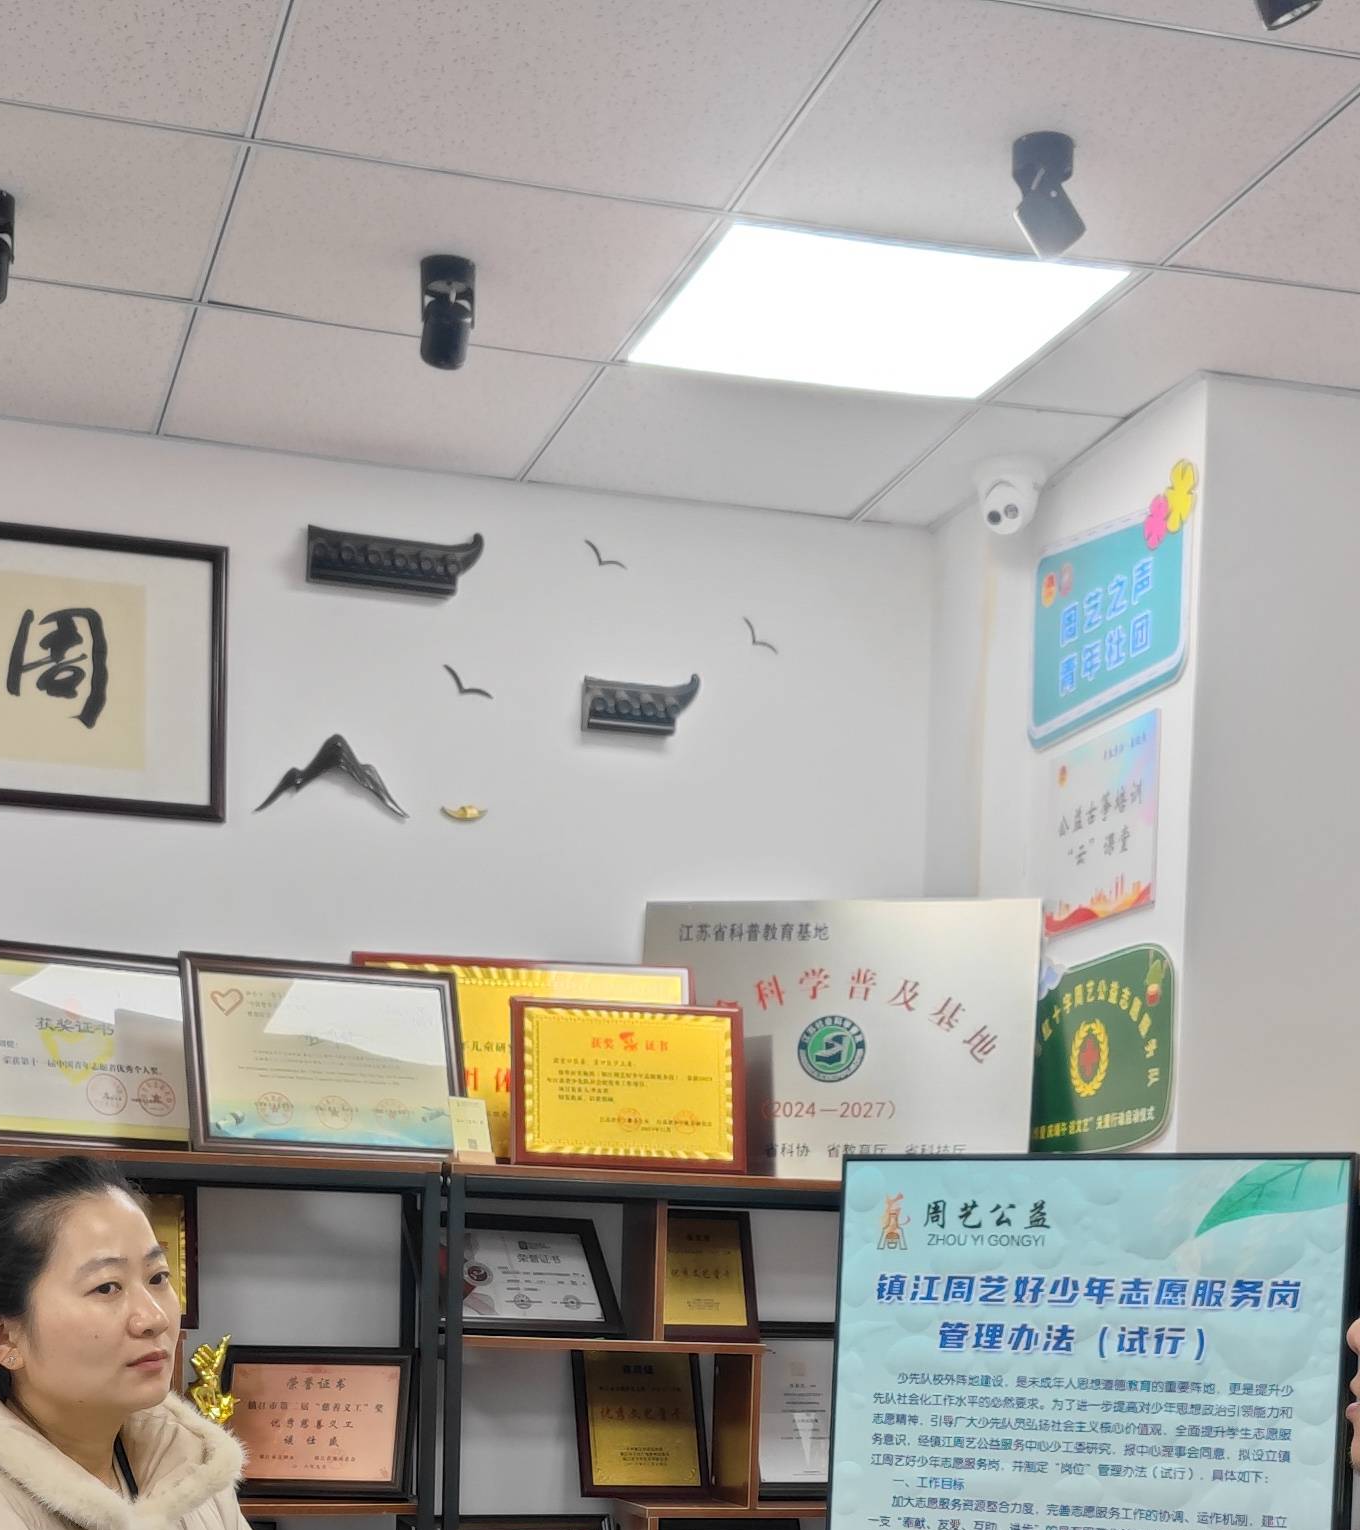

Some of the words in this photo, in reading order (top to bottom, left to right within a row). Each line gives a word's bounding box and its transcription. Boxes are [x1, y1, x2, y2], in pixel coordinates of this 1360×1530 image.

[678, 922, 830, 943] 江苏省科普教育基地
[35, 1017, 115, 1036] 获奖证书
[715, 968, 998, 1063] 科学普及基地
[923, 1197, 1051, 1232] 周艺公益
[926, 1232, 968, 1247] ZHOU
[971, 1233, 986, 1247] YI
[987, 1234, 1046, 1248] GONGYI
[876, 1273, 1302, 1311] 镇江周艺好少年志愿服务岗
[937, 1321, 1208, 1362] 管理办法（试行）
[286, 1376, 348, 1391] 荣誉证书
